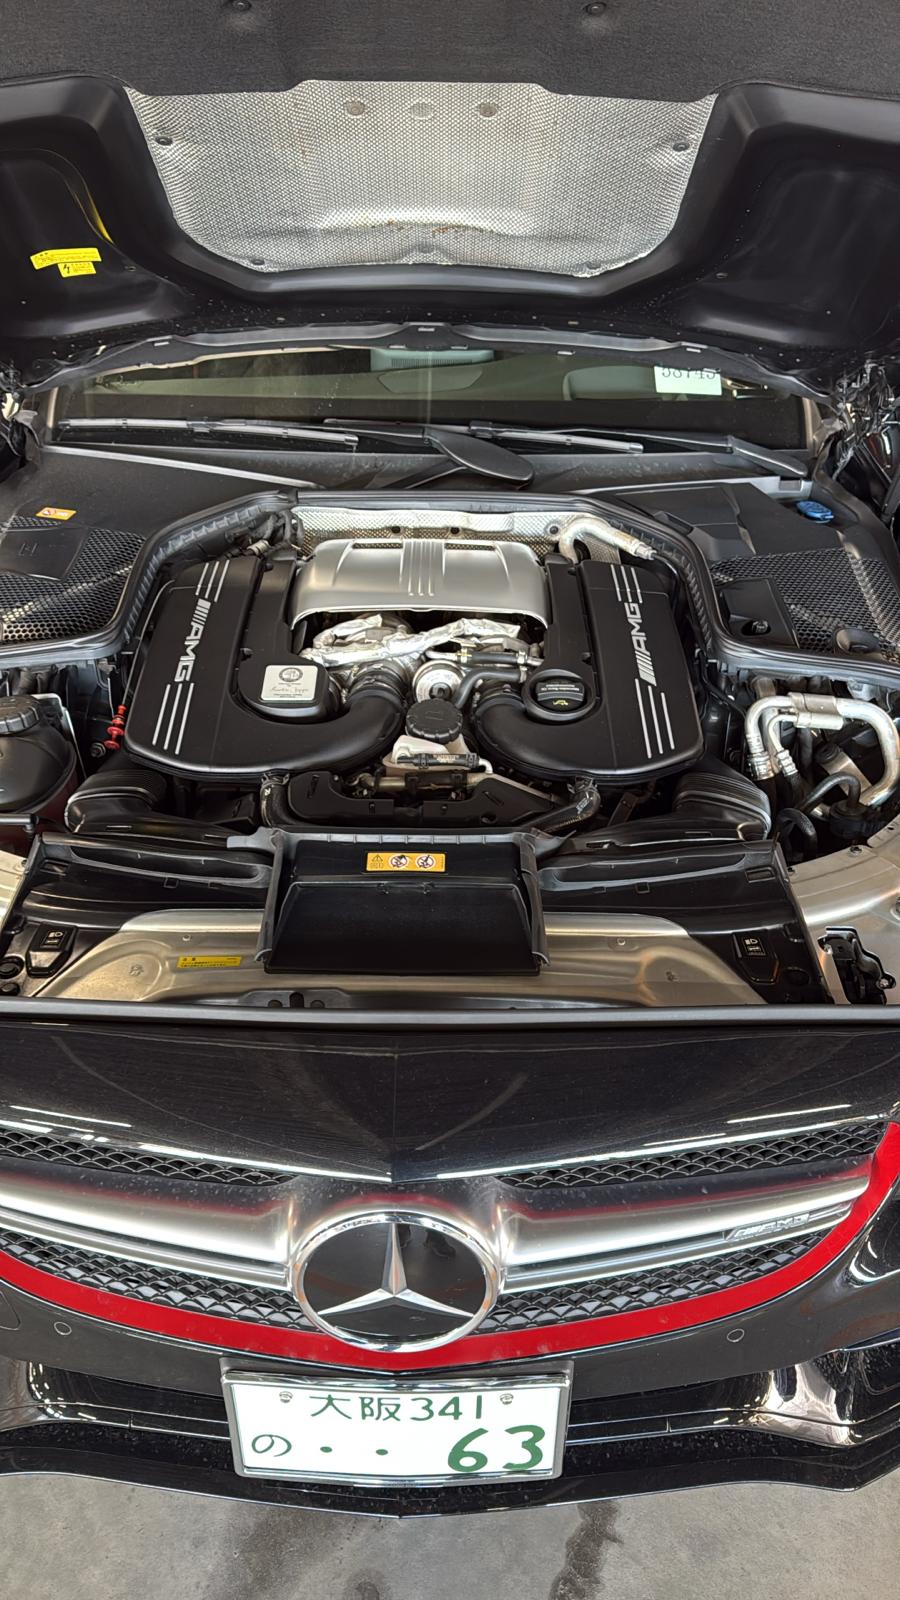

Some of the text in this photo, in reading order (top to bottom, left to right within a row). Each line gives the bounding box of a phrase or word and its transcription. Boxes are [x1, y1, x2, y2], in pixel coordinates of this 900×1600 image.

[174, 621, 204, 682] AMG
[624, 602, 651, 656] AMG
[251, 1434, 292, 1457] の
